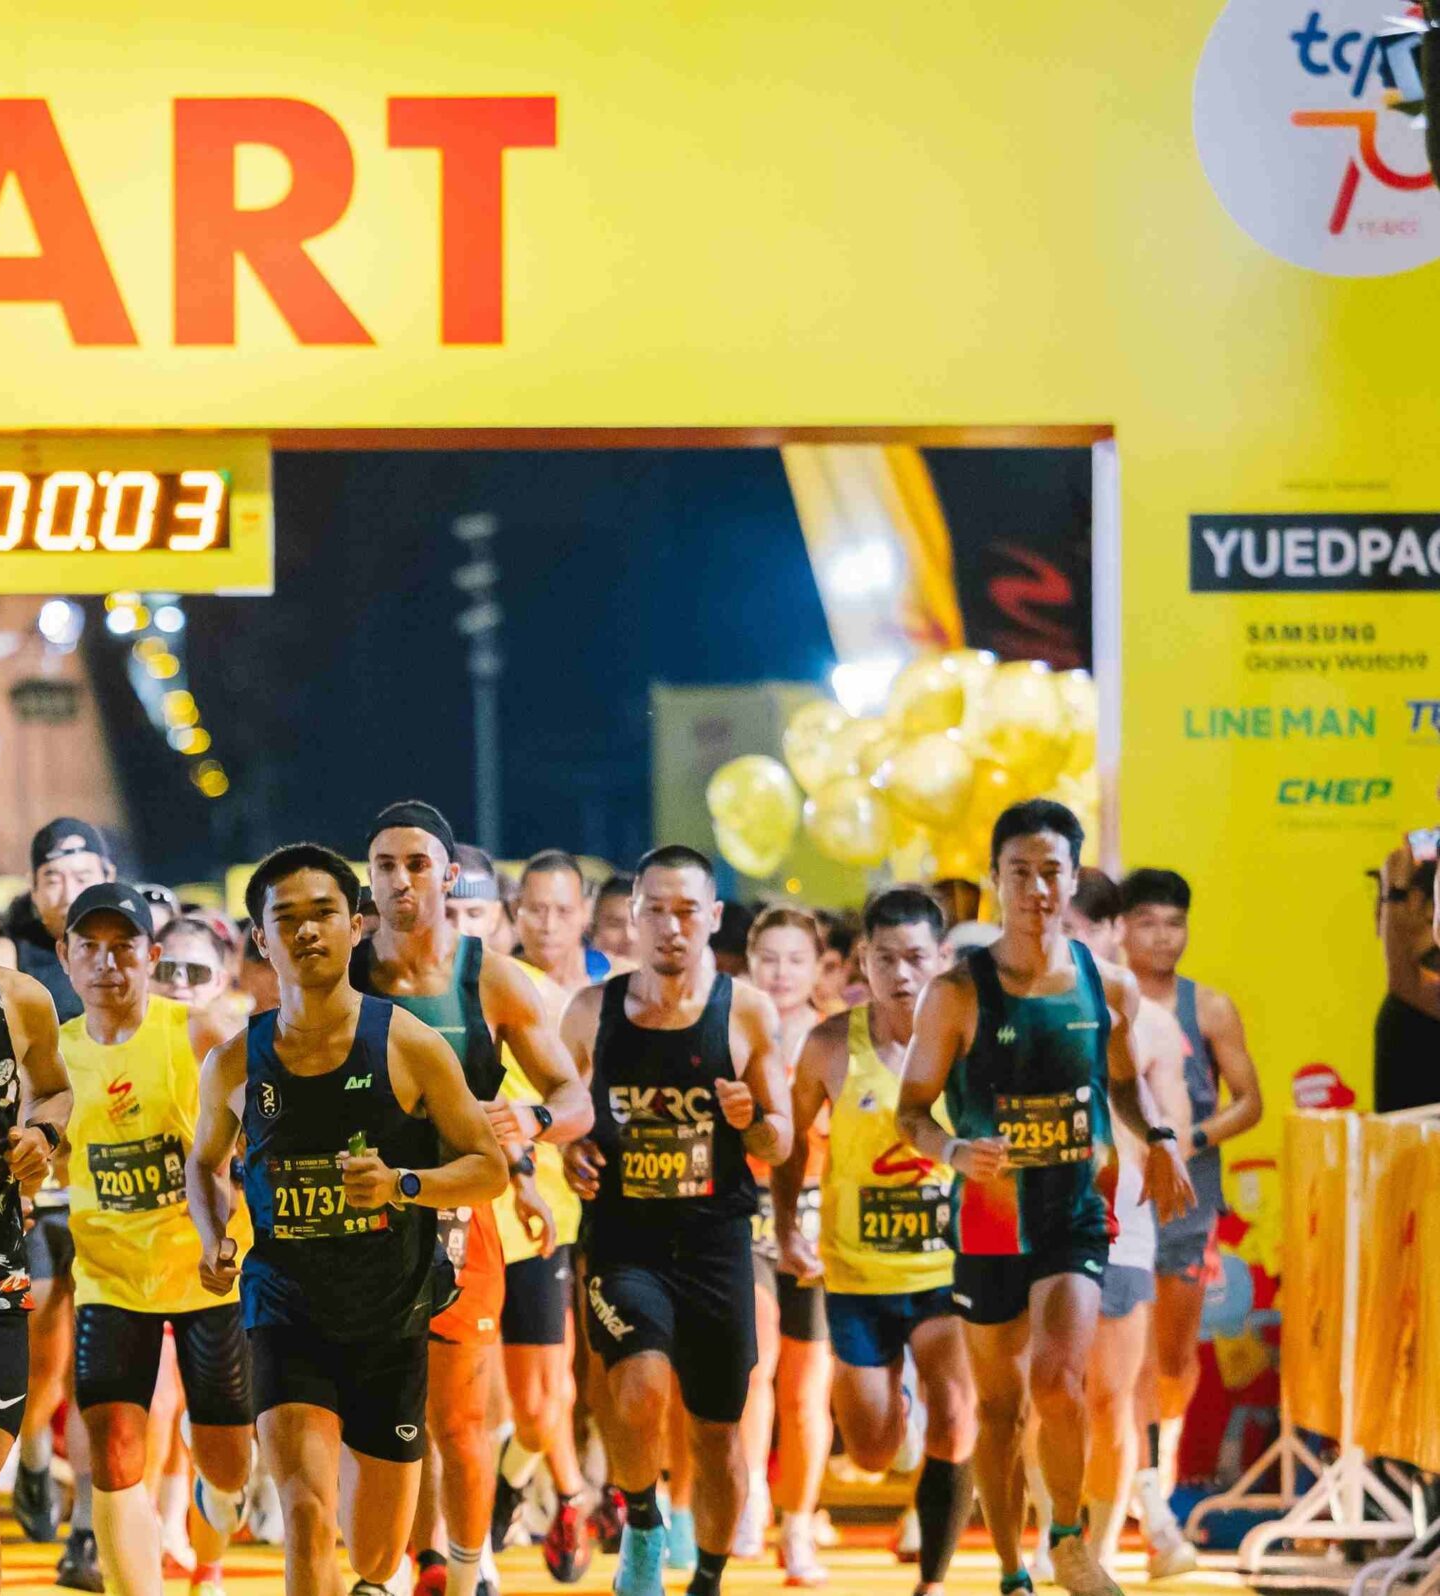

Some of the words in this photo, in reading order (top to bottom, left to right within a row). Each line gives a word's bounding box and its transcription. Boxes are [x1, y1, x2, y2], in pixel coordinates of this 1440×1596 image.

[1247, 624, 1376, 642] SAMSUNG
[1246, 656, 1329, 675] Galaxy
[1278, 778, 1393, 804] CHEP
[344, 1073, 372, 1090] Ari
[608, 1087, 713, 1124] 5KRC
[998, 1119, 1068, 1149] 22354
[623, 1151, 687, 1179] 22099
[96, 1165, 160, 1196] 22019
[275, 1185, 346, 1217] 21737
[863, 1211, 929, 1237] 21791
